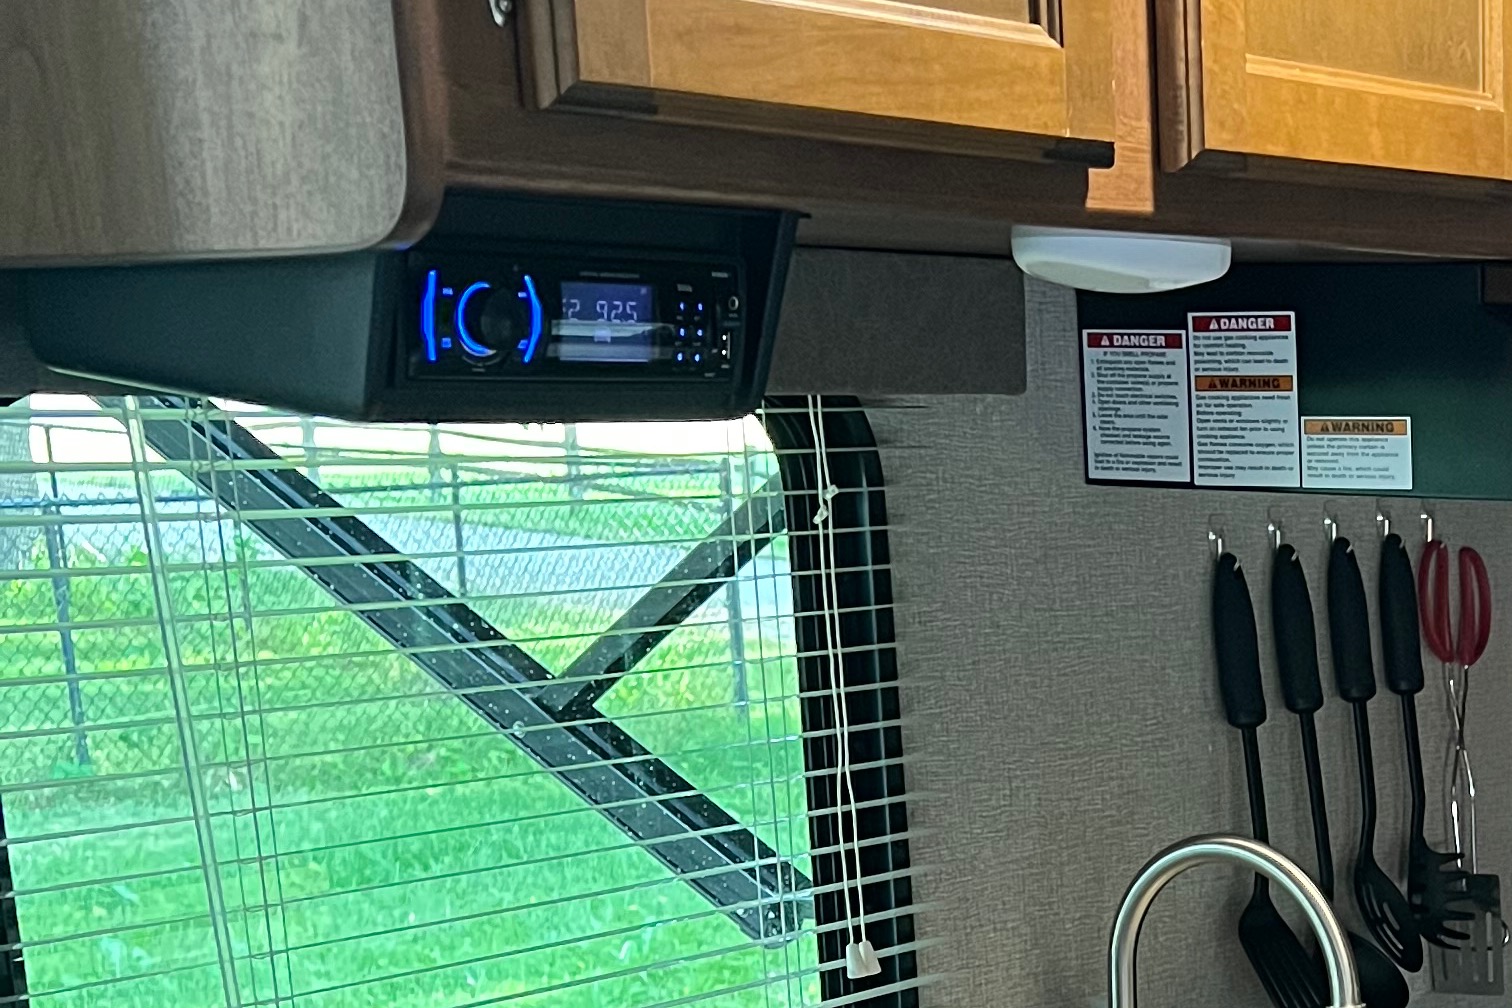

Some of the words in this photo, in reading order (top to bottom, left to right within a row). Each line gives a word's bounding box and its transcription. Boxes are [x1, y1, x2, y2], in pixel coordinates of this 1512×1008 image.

[1220, 318, 1275, 330] DANGER
[1113, 335, 1166, 347] DANGER
[1219, 379, 1280, 389] WARNING
[1331, 422, 1395, 433] WARNING
